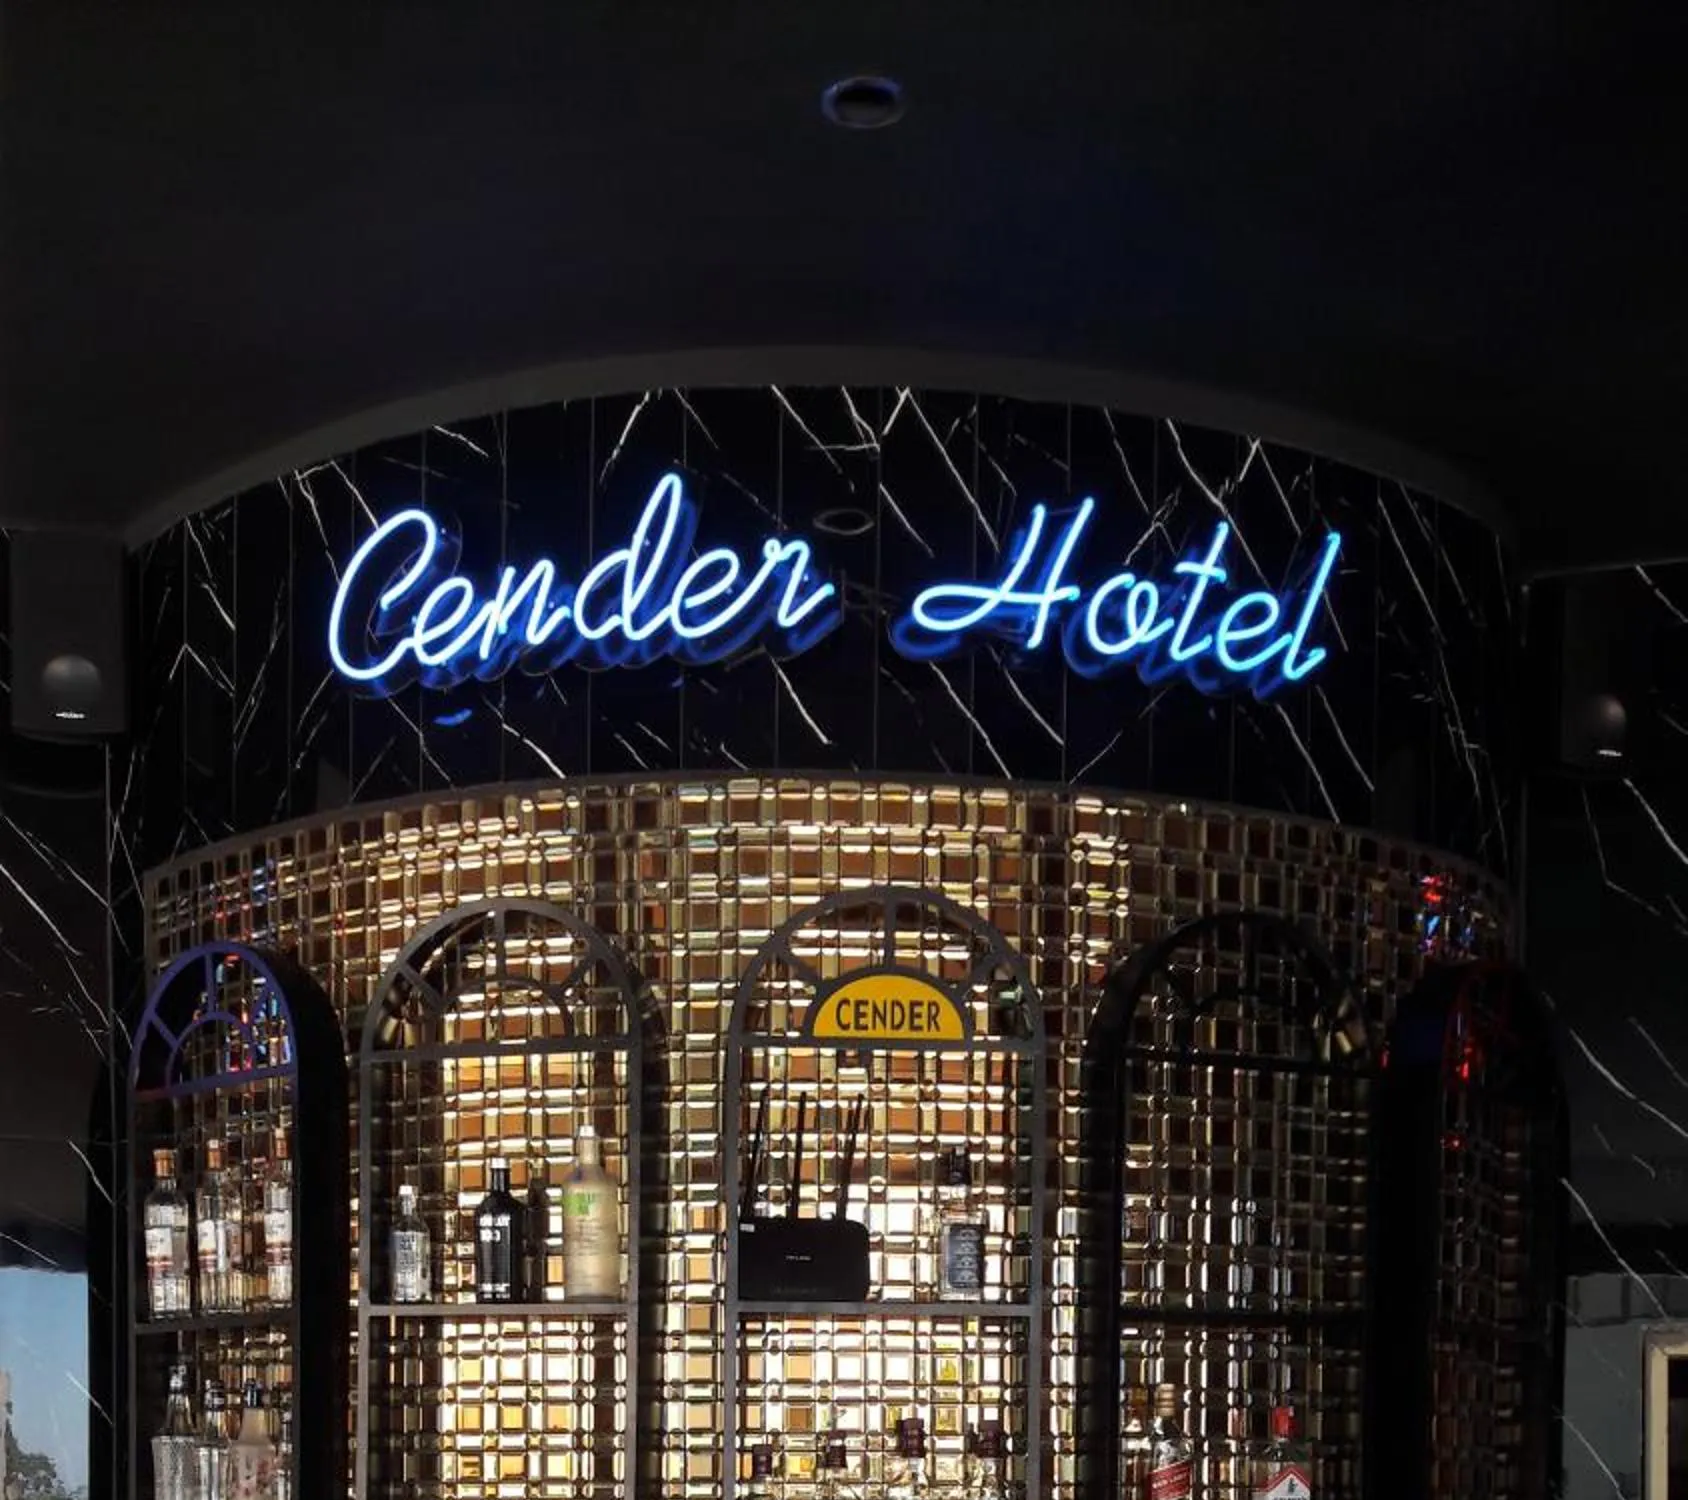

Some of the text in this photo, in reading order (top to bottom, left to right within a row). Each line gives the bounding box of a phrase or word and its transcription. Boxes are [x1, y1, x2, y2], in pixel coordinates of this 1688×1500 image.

[329, 472, 1342, 681] Cender Hotel
[835, 996, 941, 1033] CENDER
